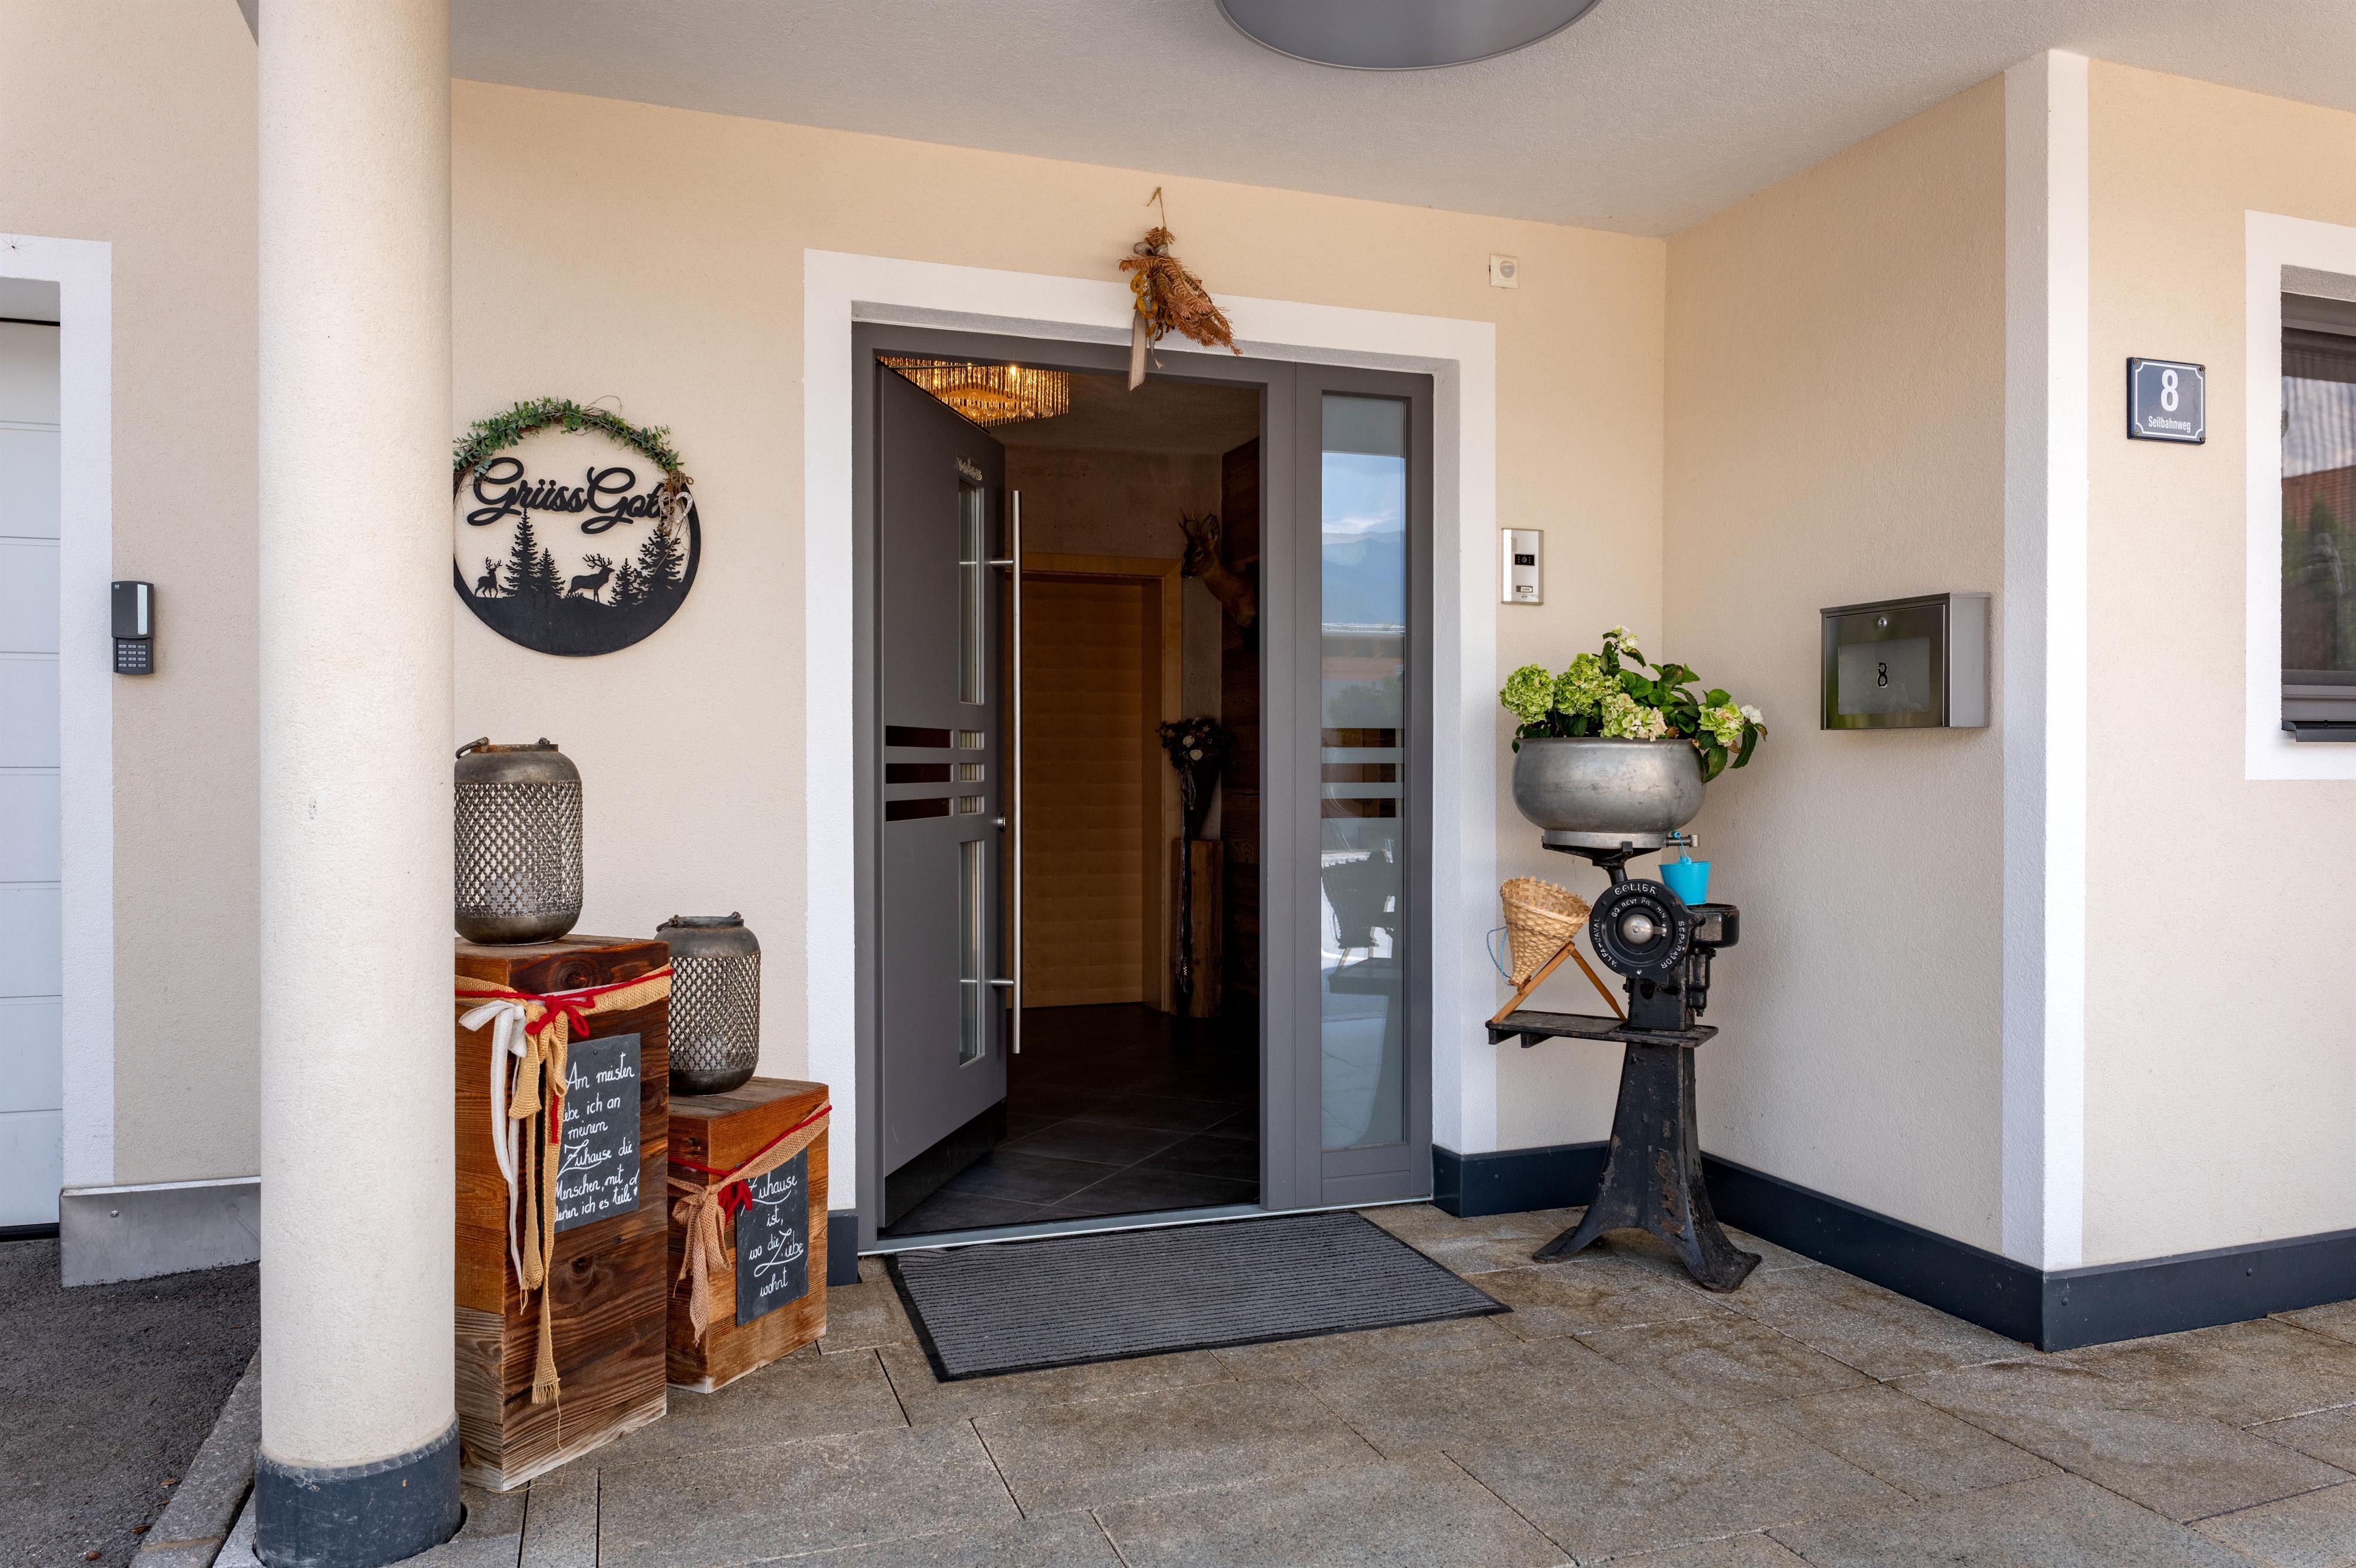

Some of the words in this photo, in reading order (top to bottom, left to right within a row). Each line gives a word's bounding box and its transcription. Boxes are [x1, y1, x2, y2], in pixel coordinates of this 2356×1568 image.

[2160, 369, 2179, 412] 8
[2148, 416, 2191, 433] Seilbahnweg
[1877, 662, 1888, 688] 8
[1660, 921, 1685, 970] SEPARATOR
[565, 1061, 590, 1091] Am
[596, 1052, 635, 1084] meisten
[587, 1092, 603, 1115] ich
[607, 1097, 621, 1110] an
[567, 1120, 608, 1140] meinem
[556, 1139, 612, 1180] Zuhause
[618, 1137, 633, 1156] die
[604, 1163, 624, 1186] mit
[581, 1196, 595, 1215] ich
[598, 1200, 609, 1209] es
[749, 1245, 762, 1261] wo
[767, 1233, 780, 1251] die
[759, 1266, 789, 1297] wohnt
